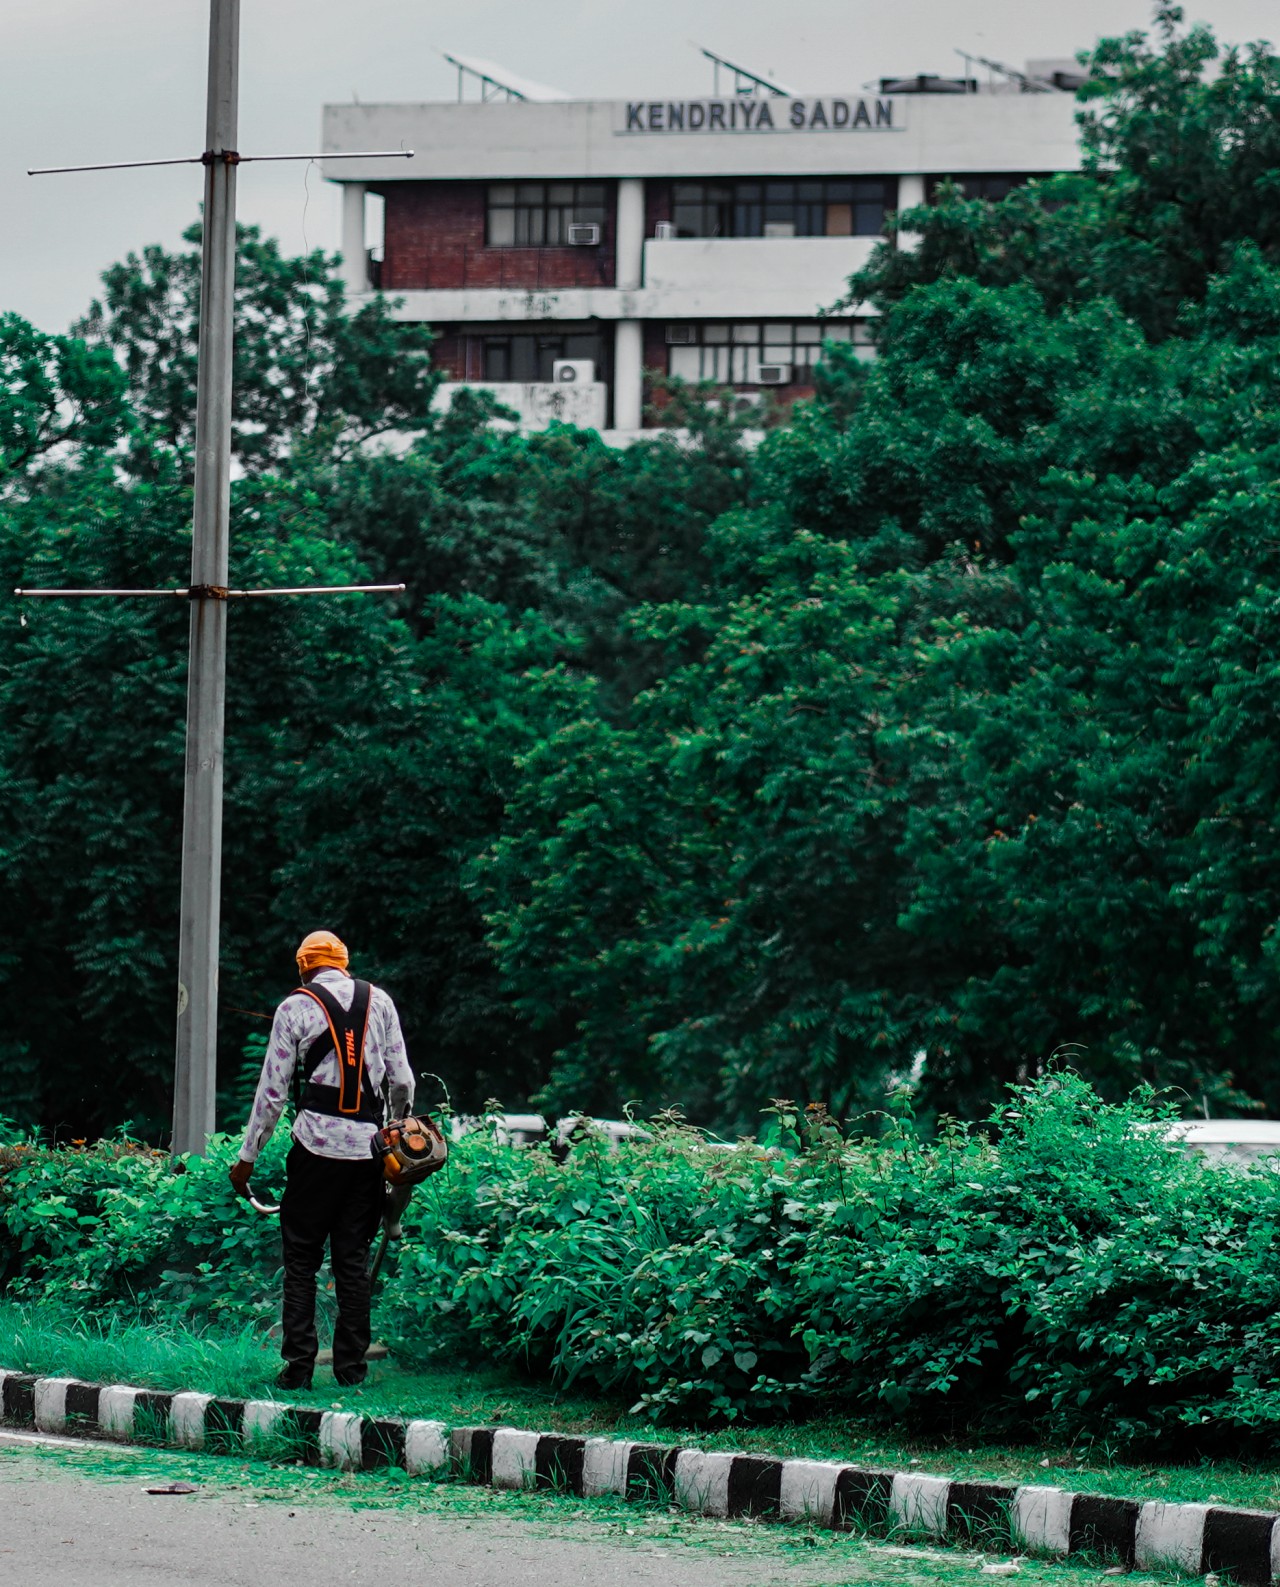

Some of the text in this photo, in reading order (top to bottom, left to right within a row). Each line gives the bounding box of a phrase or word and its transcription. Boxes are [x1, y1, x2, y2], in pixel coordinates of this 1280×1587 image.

[626, 100, 892, 131] KENDRIYA SADAN
[345, 1028, 356, 1067] STIHL
